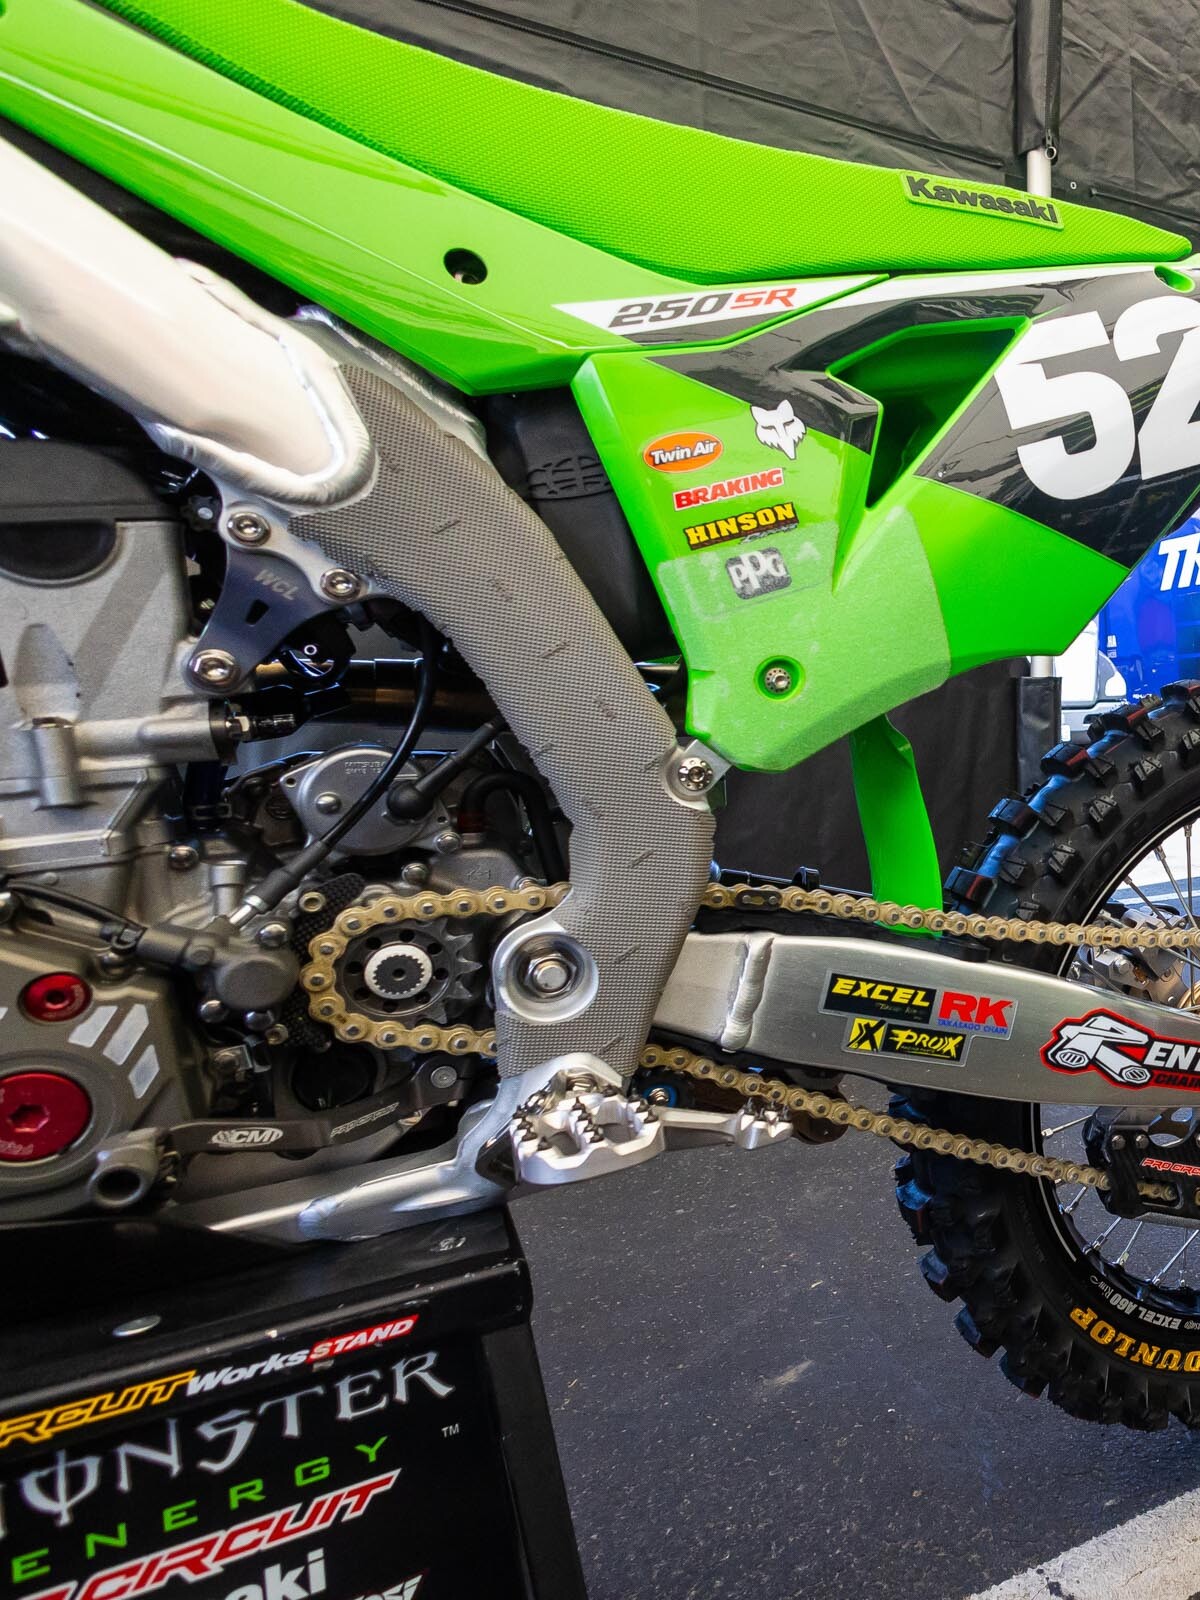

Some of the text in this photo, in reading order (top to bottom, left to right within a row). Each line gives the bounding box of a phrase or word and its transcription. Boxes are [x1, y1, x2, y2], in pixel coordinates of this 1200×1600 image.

[906, 175, 1058, 223] Kawasaki
[608, 287, 797, 329] 250SR
[651, 440, 717, 466] Twin Air
[674, 468, 784, 510] BRAKING
[684, 502, 796, 546] HINSON
[831, 977, 931, 1007] EXCEL
[938, 990, 1014, 1027] RK
[937, 1018, 1009, 1035] TAKASAGO CHAIN
[1142, 1158, 1172, 1171] PRO
[1109, 1293, 1138, 1315] A60
[1138, 1306, 1182, 1331] EXCEL
[309, 1319, 416, 1360] STAND
[0, 1351, 456, 1539] ONSTER
[12, 1437, 388, 1583] ENERGY
[77, 1468, 401, 1600] CIRCUIT
